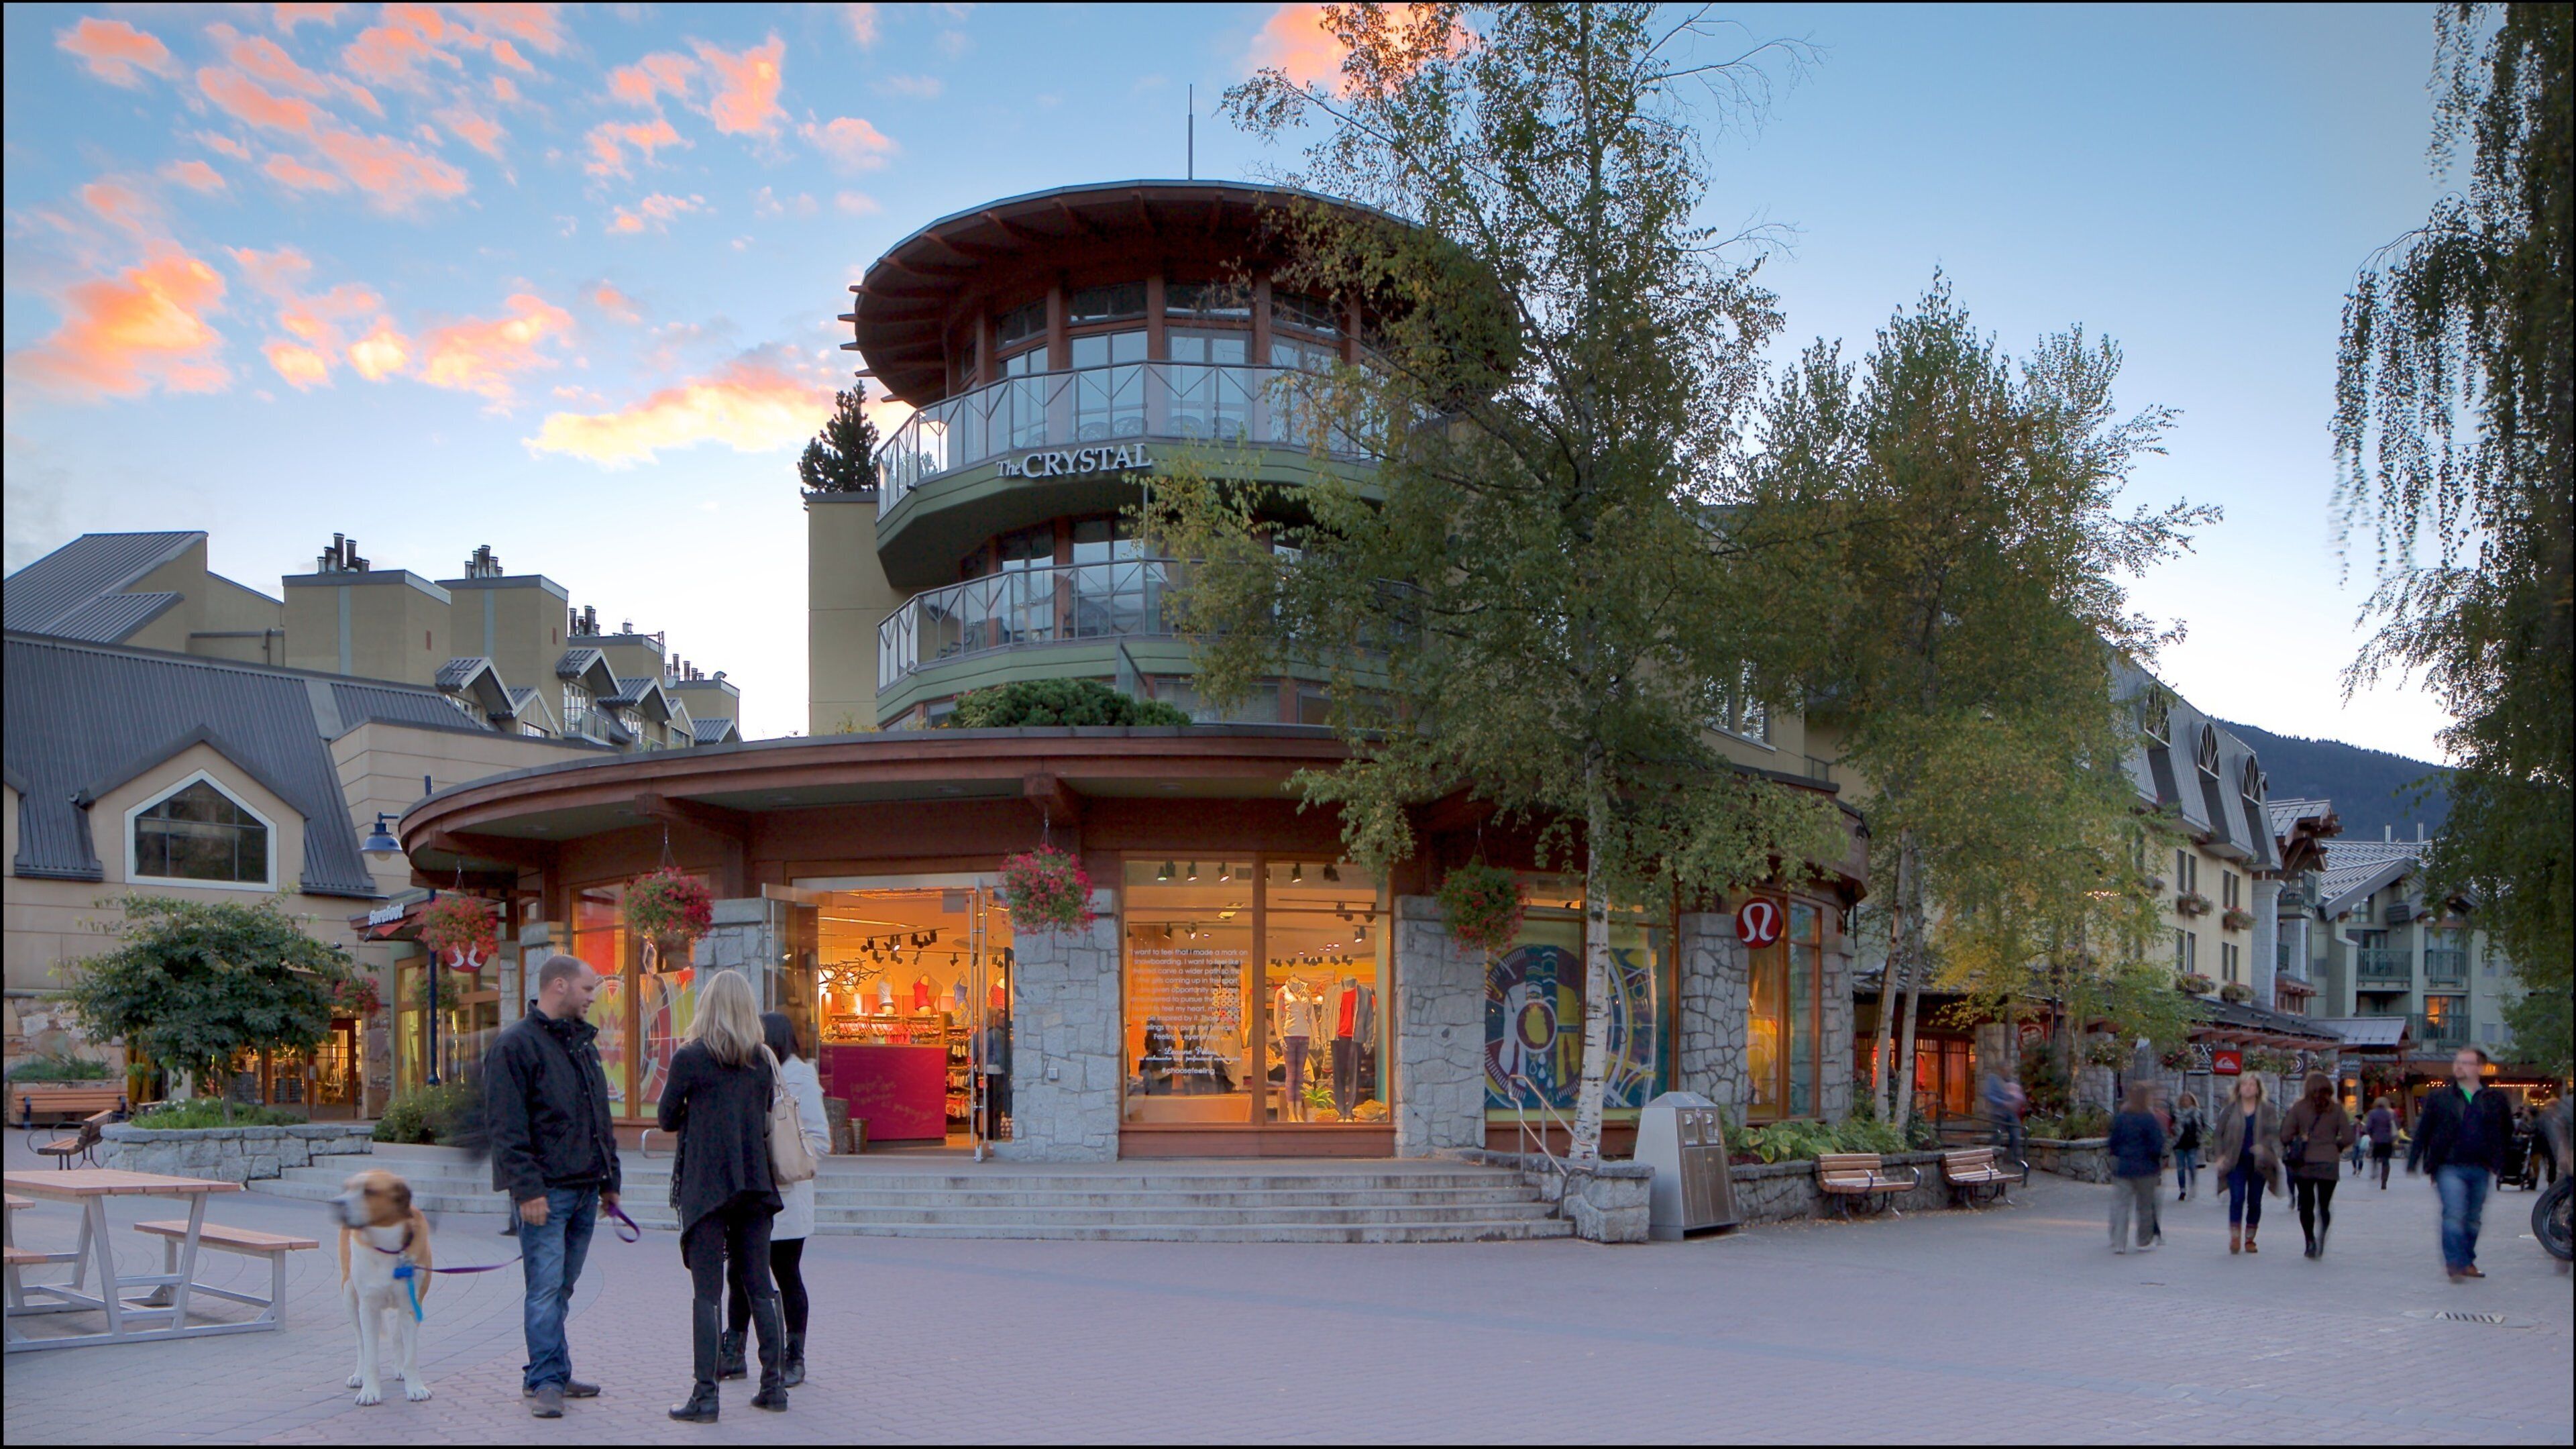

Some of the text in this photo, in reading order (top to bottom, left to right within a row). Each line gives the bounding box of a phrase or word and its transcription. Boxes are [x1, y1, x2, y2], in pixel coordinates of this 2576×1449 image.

[996, 443, 1152, 478] The CRYSTAL
[1165, 977, 1190, 985] coming
